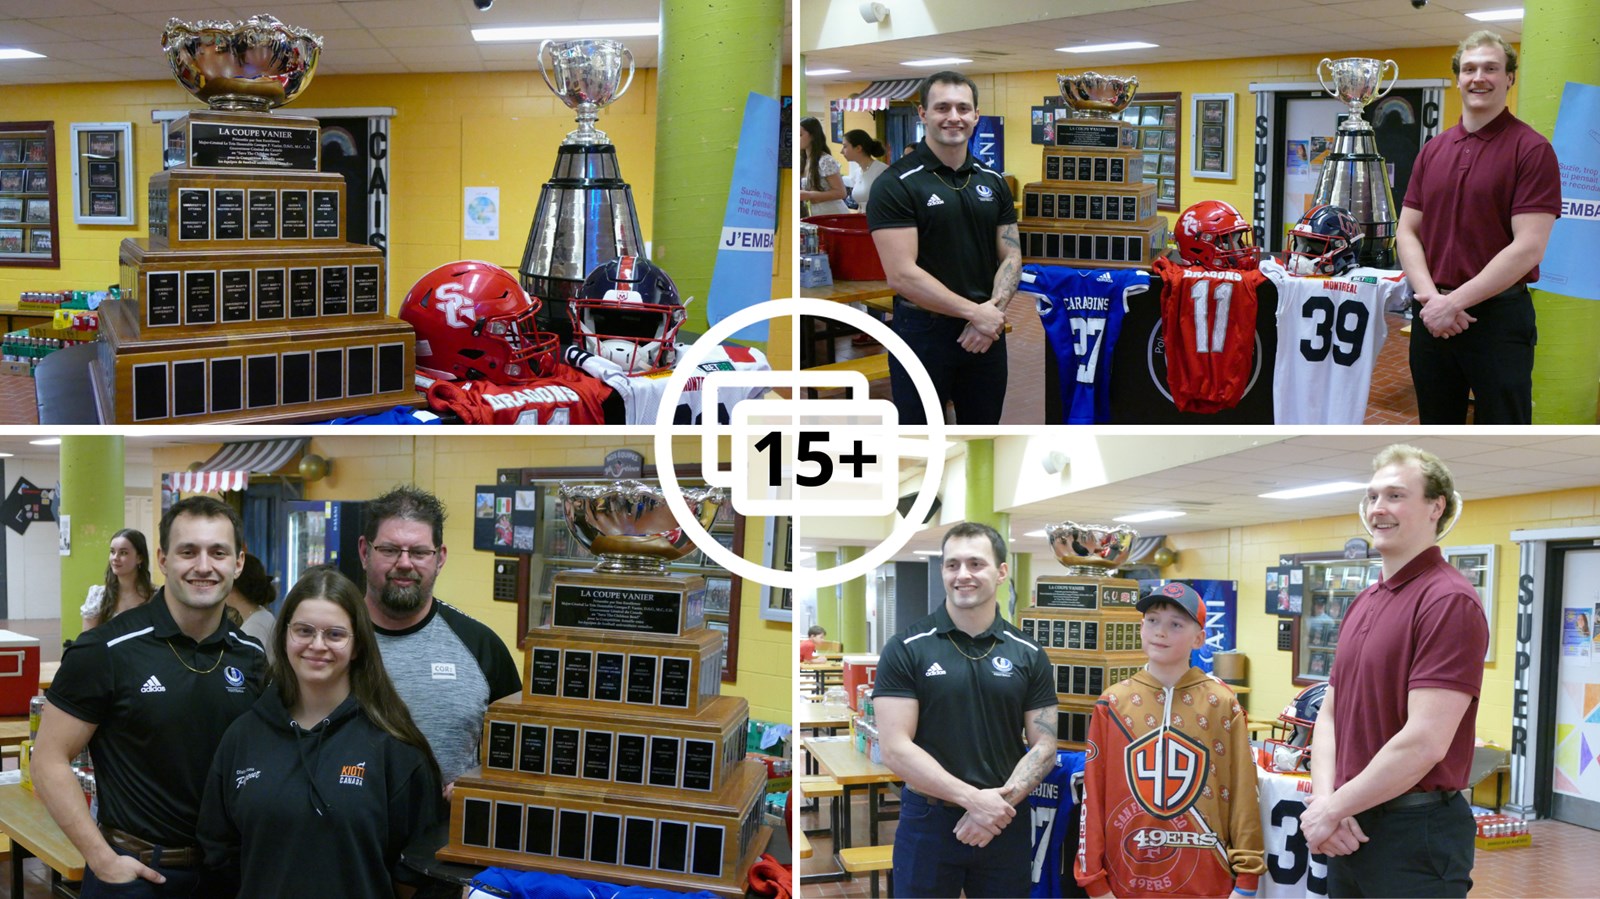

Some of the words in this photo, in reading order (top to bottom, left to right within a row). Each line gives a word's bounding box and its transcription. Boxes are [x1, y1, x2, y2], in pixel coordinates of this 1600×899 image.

[262, 130, 292, 138] VANIER
[1570, 174, 1598, 184] pensait
[1584, 167, 1598, 176] trop
[1254, 116, 1268, 249] SUPER
[368, 132, 387, 258] CAIS
[1183, 270, 1243, 282] DRAGONS
[1191, 280, 1233, 353] 11
[1300, 296, 1370, 366] 39
[482, 385, 580, 412] DRAGONS
[593, 590, 621, 599] COUPE
[622, 592, 654, 601] VANIER
[1511, 574, 1534, 757] SUPER
[339, 777, 363, 786] CANADA
[1136, 738, 1196, 807] 49
[1114, 808, 1132, 829] SAN
[1133, 830, 1218, 847] 49ERS
[1129, 876, 1172, 891] 49ERS
